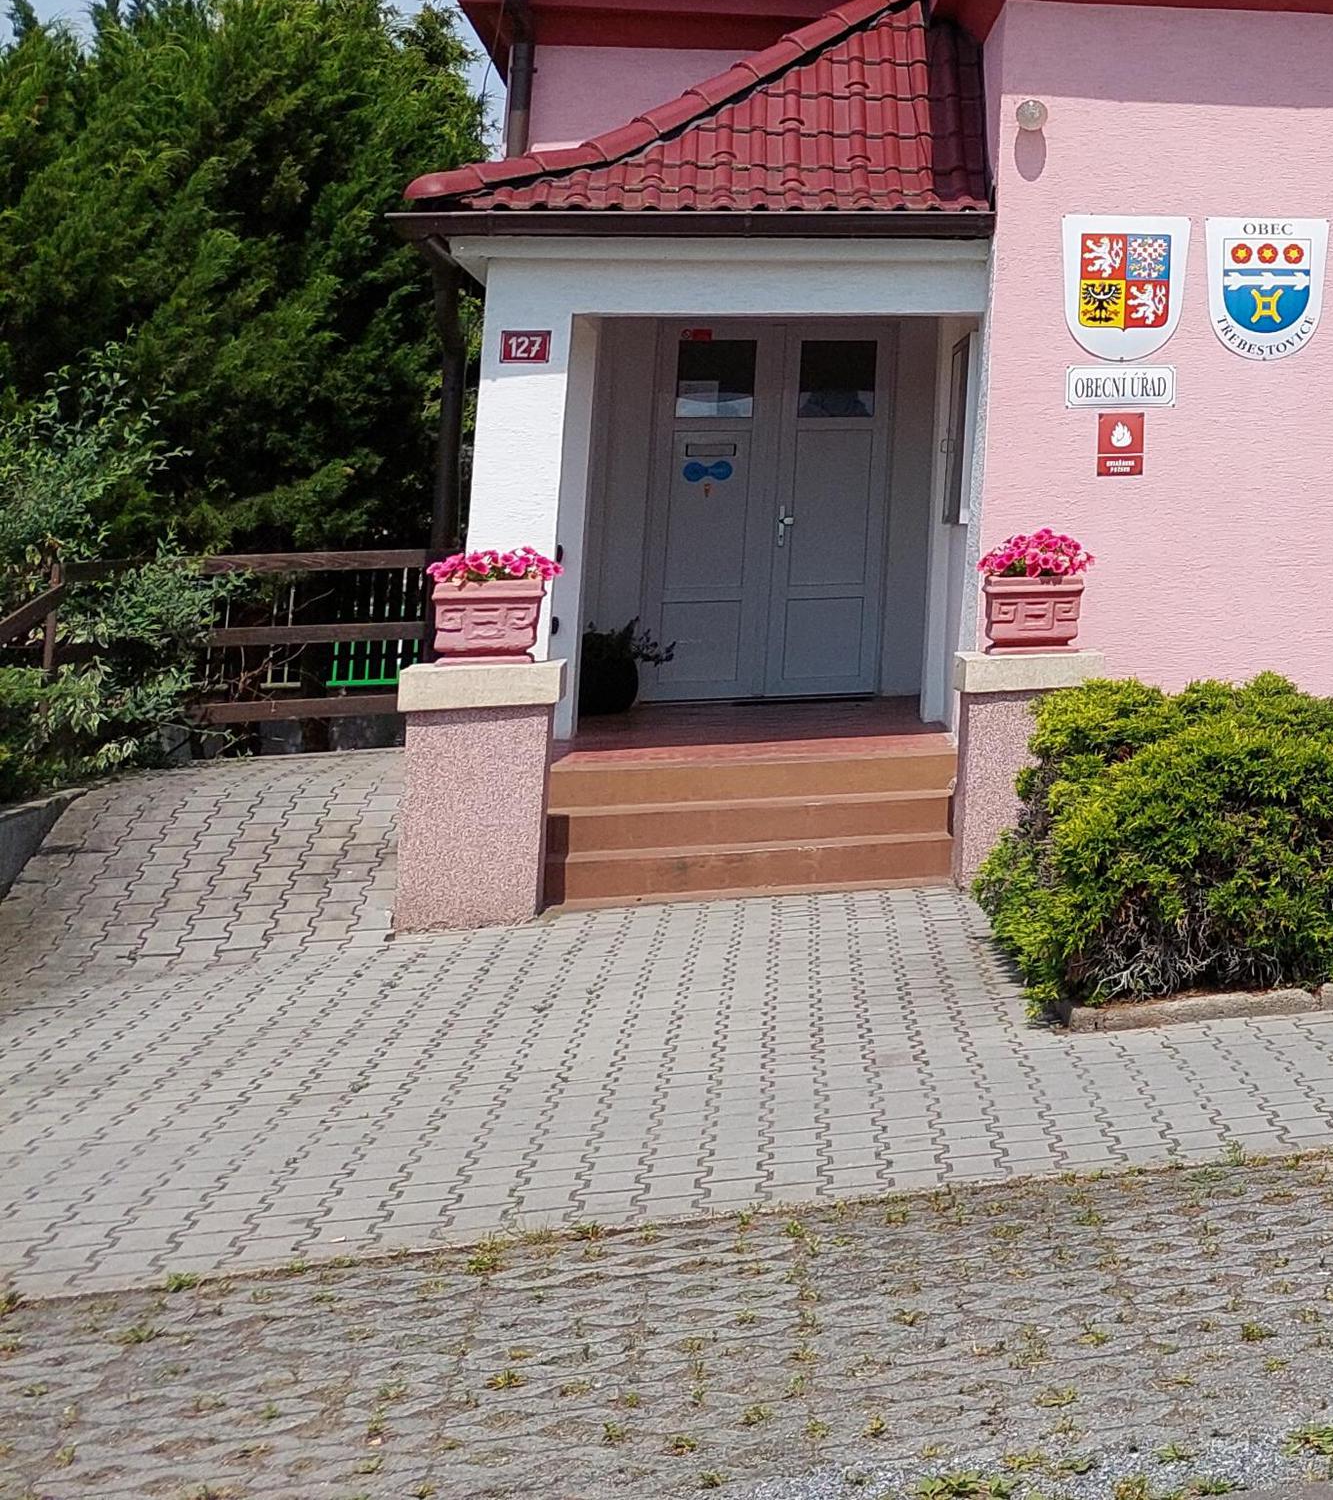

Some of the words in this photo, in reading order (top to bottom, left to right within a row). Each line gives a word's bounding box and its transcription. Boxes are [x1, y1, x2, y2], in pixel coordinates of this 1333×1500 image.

[1243, 223, 1294, 235] OBEC
[508, 336, 542, 358] 127
[1217, 315, 1316, 356] TŘEBESTOVICE
[1074, 371, 1127, 398] OBECNÍ
[1131, 371, 1167, 398] ÚŘAD
